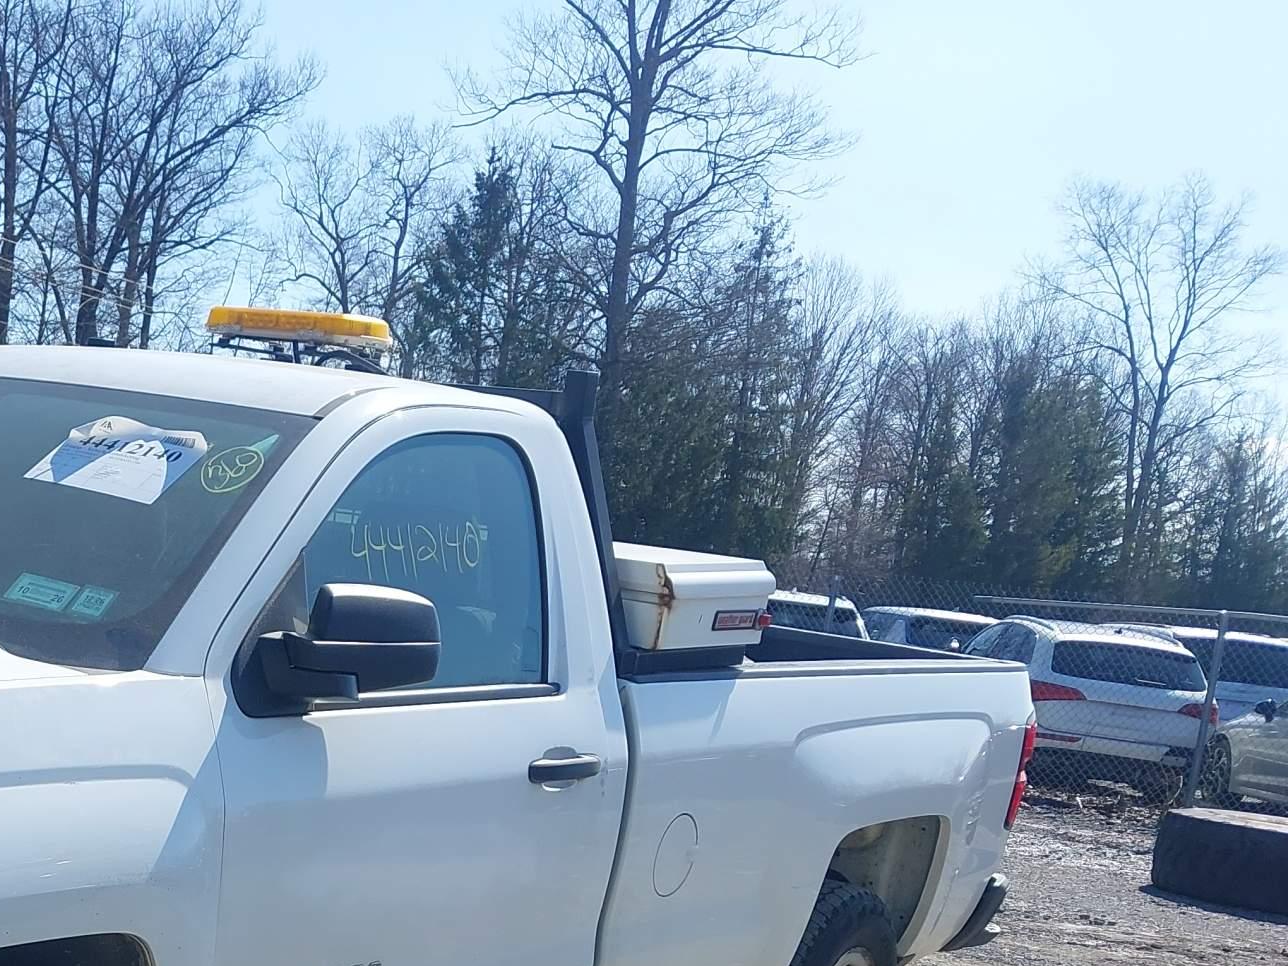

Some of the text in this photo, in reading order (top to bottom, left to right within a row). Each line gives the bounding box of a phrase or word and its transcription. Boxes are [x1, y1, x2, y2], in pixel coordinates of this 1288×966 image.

[79, 434, 182, 464] 44412140
[350, 520, 481, 583] 44412140
[17, 585, 31, 594] 10
[50, 594, 65, 603] 26
